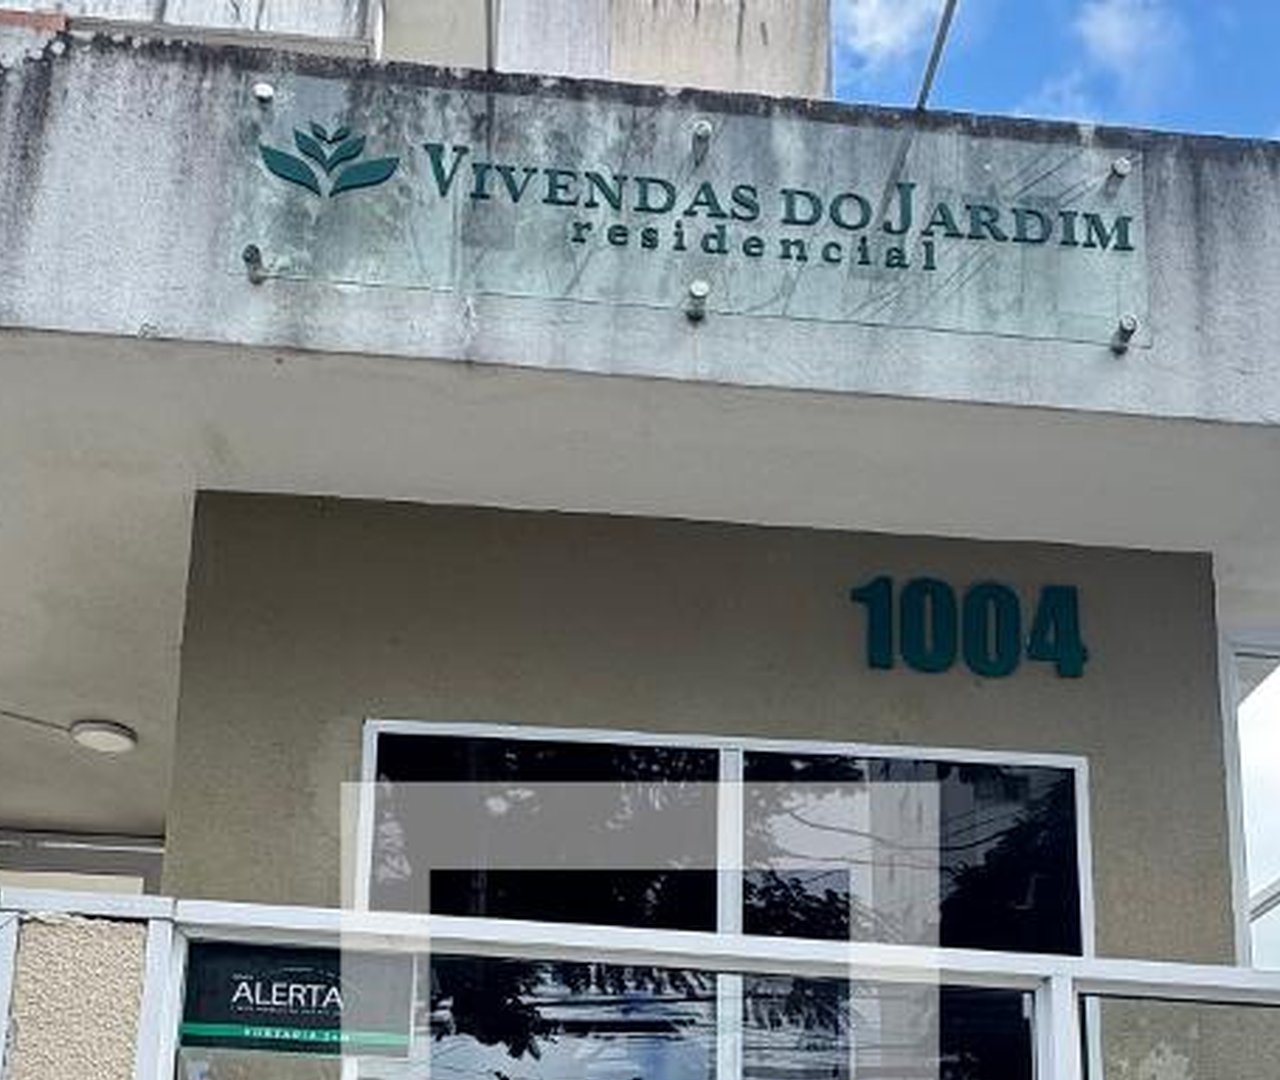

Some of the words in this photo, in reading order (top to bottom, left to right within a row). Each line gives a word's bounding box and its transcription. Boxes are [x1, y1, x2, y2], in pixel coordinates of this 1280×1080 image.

[423, 143, 761, 221] VIVENDAS
[572, 219, 937, 270] residencial
[850, 575, 1089, 679] 1004
[231, 981, 344, 1010] ALERTA
